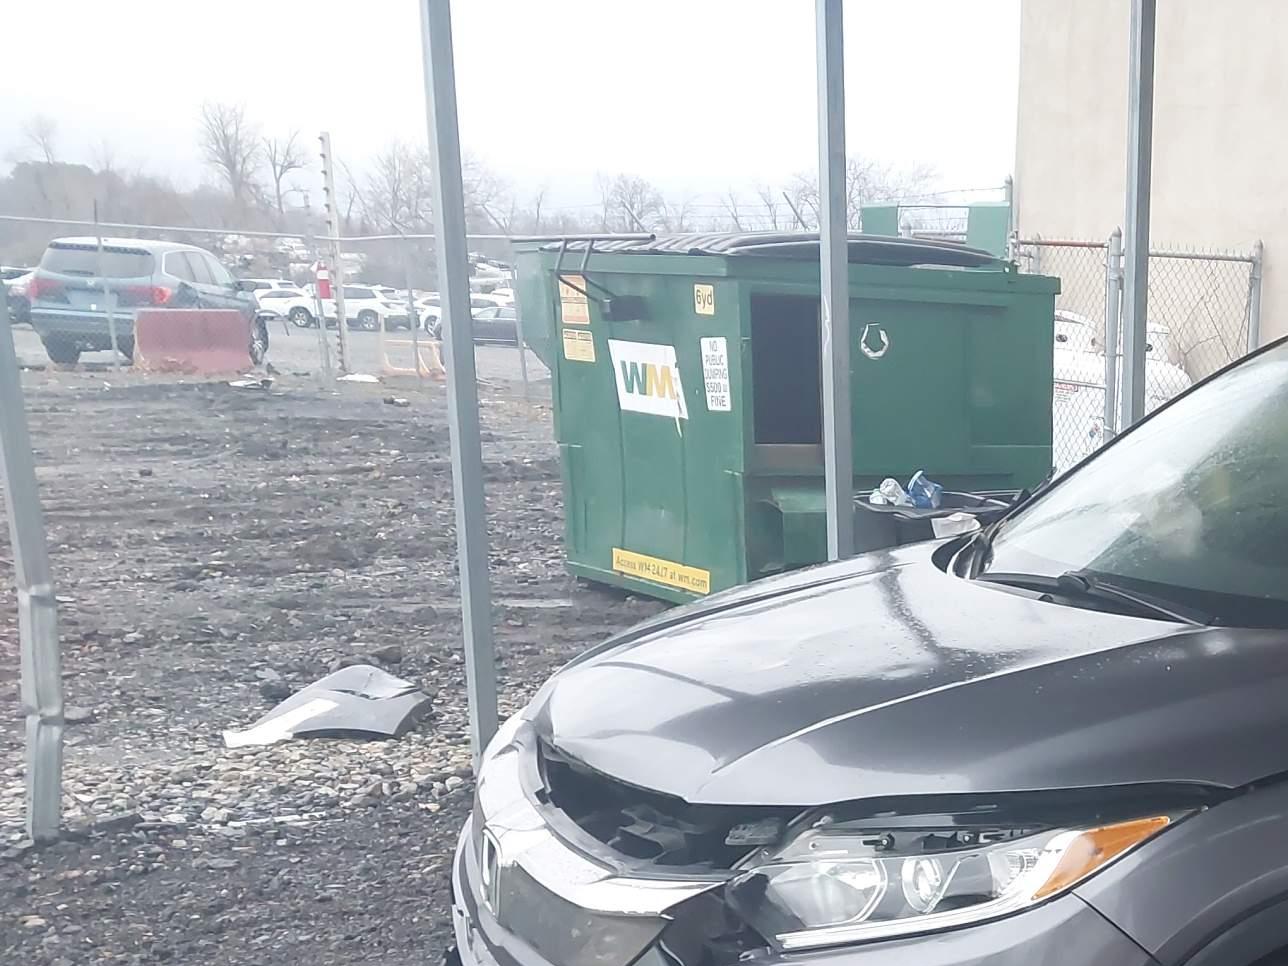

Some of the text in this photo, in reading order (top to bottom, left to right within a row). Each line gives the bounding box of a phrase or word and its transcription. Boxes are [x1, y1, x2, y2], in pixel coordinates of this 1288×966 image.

[696, 288, 713, 310] 6yd
[620, 359, 677, 400] WM
[710, 395, 727, 407] FINE
[669, 570, 676, 580] at
[678, 574, 708, 588] wm.com
